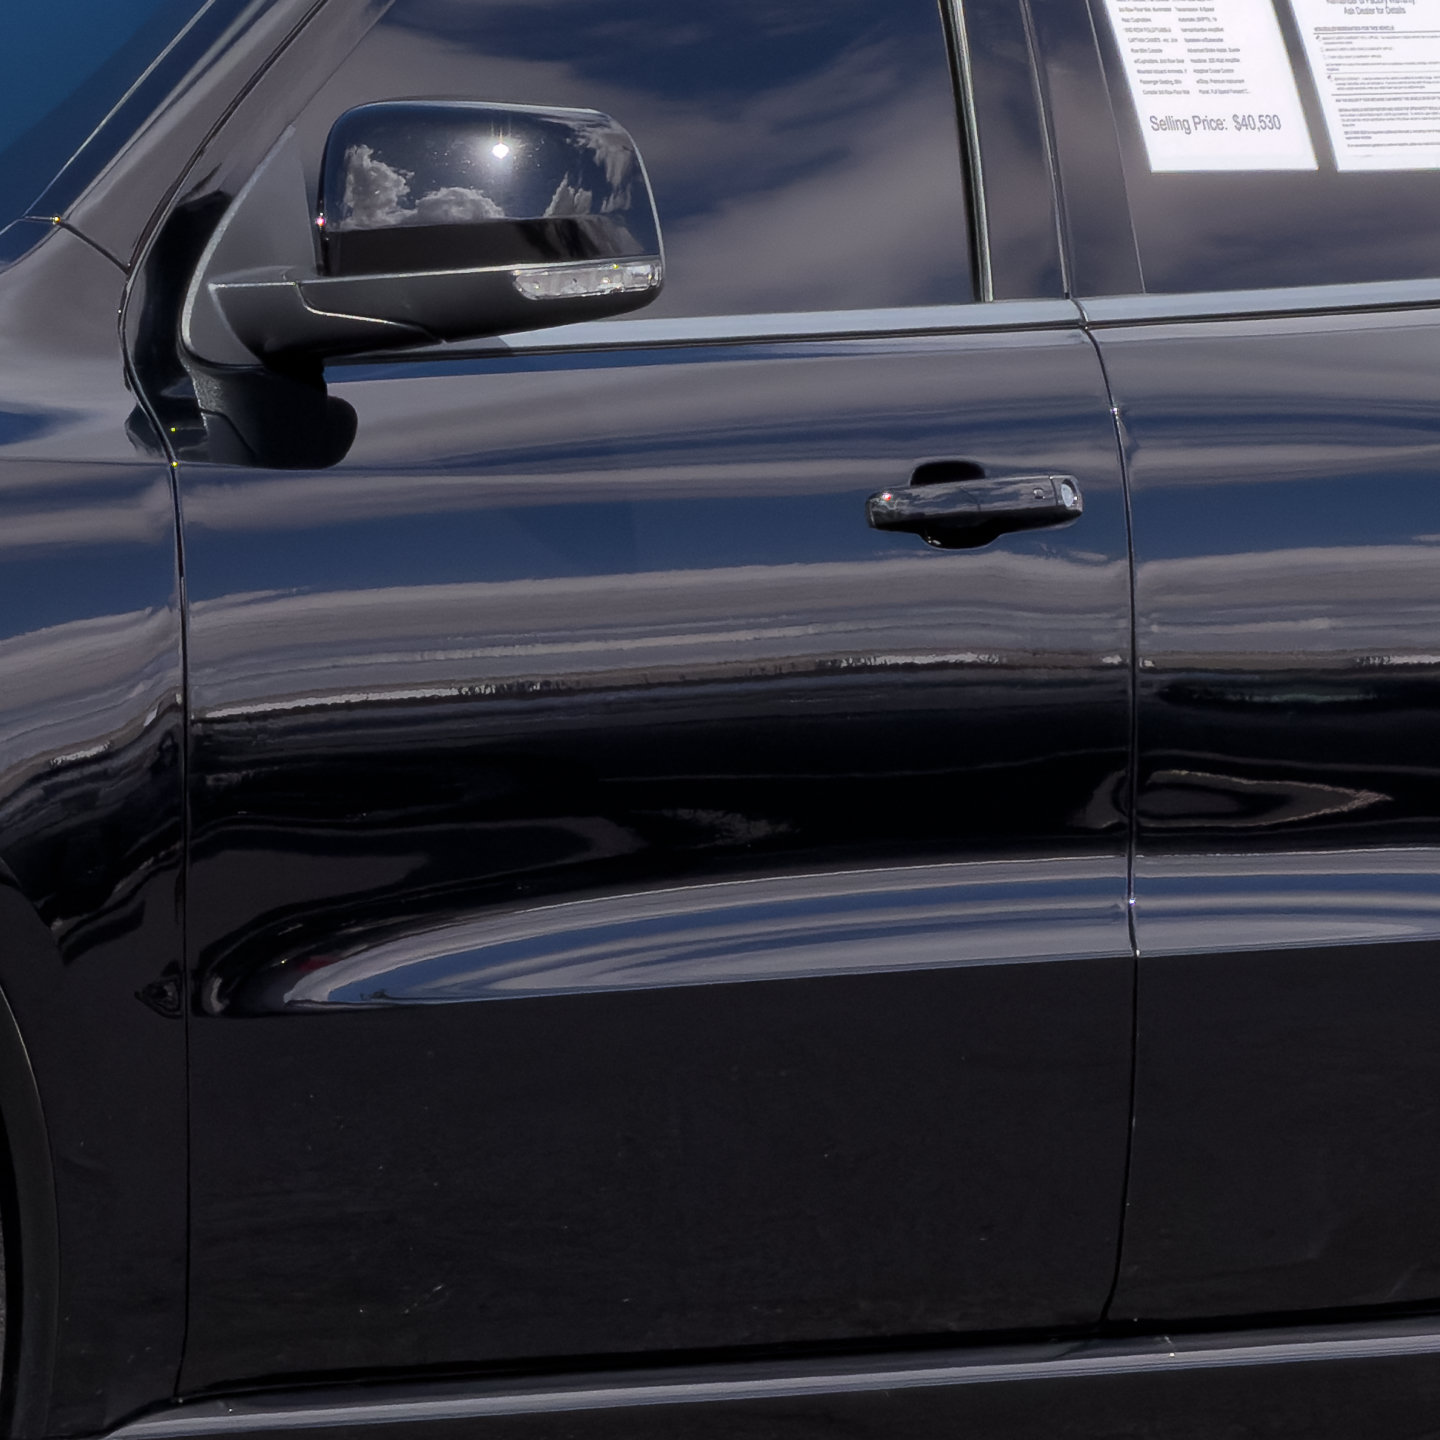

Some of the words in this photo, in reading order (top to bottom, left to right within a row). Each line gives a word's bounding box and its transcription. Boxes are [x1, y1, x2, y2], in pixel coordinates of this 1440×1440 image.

[1149, 115, 1192, 135] Selling
[1192, 115, 1228, 132] Price:
[1232, 113, 1282, 133] $40,530
